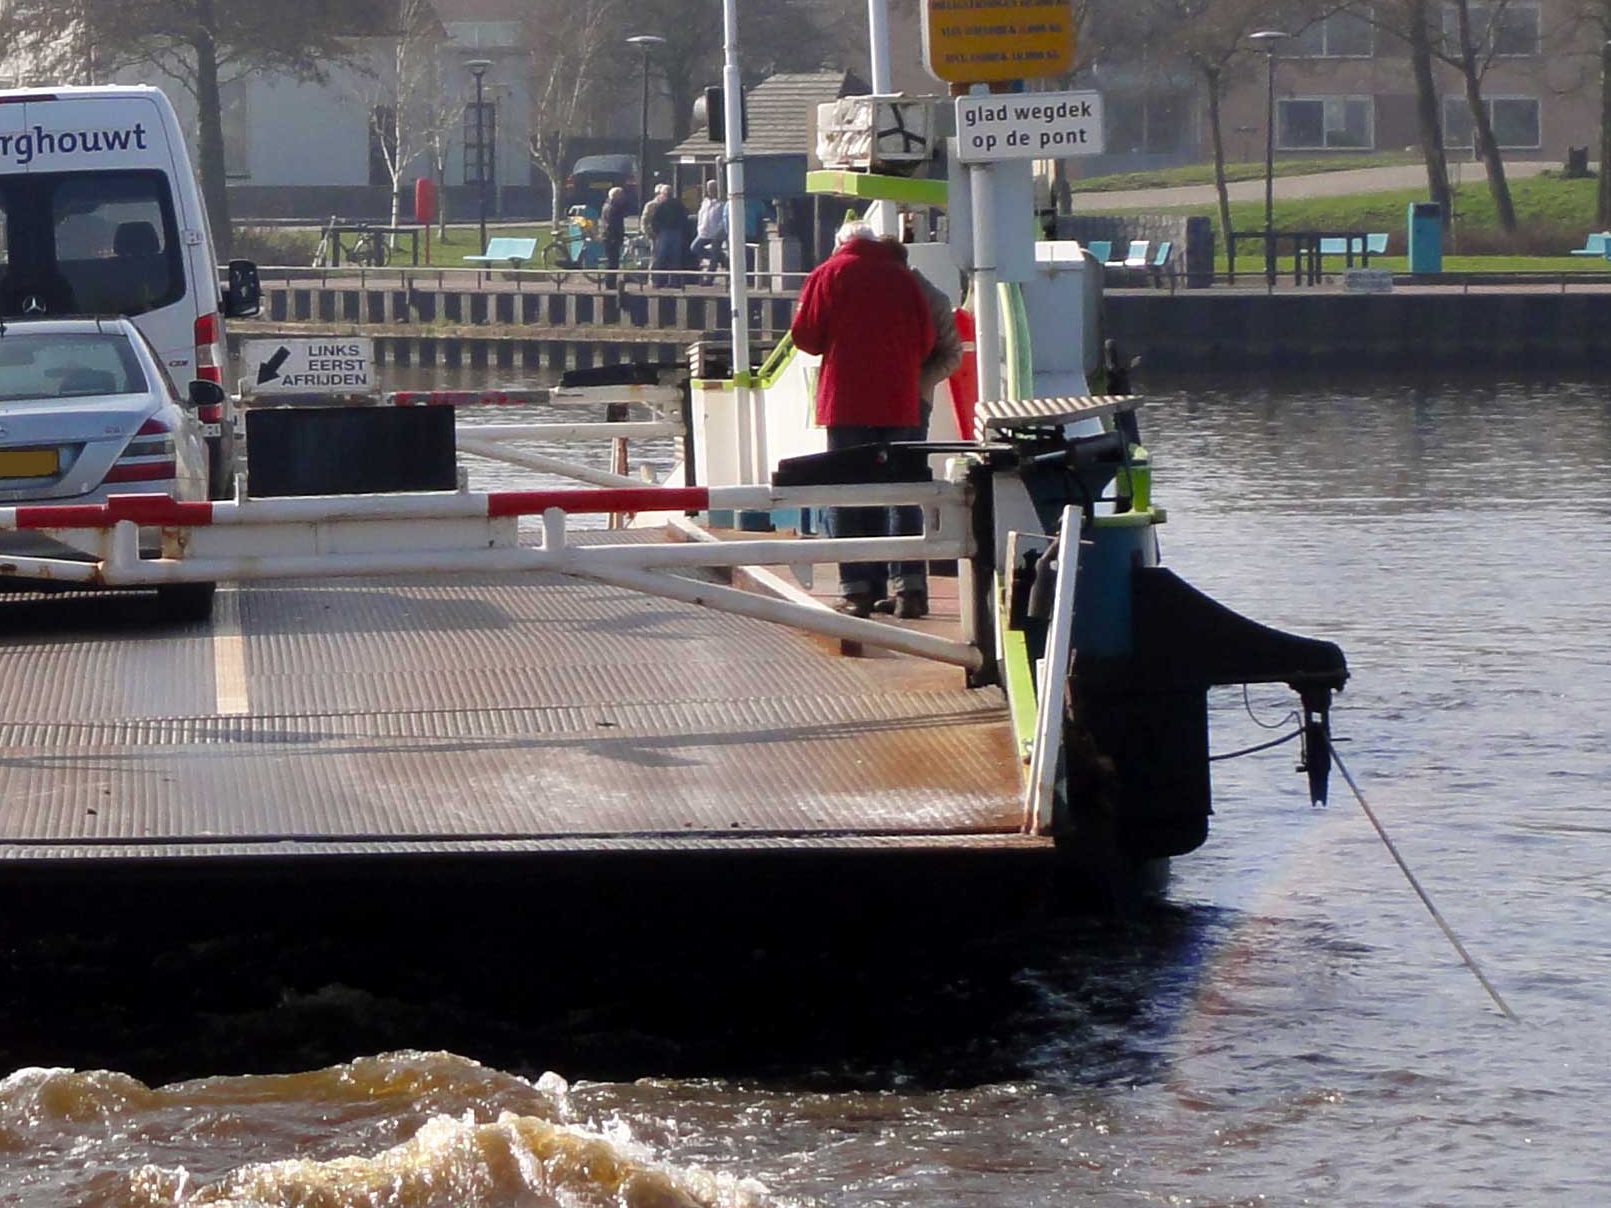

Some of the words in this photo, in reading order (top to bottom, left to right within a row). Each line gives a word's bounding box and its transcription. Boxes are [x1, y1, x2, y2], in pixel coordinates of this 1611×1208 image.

[965, 104, 1007, 126] glad
[1014, 101, 1092, 123] wegdek
[972, 134, 997, 151] op
[1006, 130, 1030, 146] de
[1040, 128, 1087, 148] pont
[308, 345, 359, 357] LINKS
[309, 359, 366, 371] EERST
[281, 373, 367, 386] AFRIJDEN
